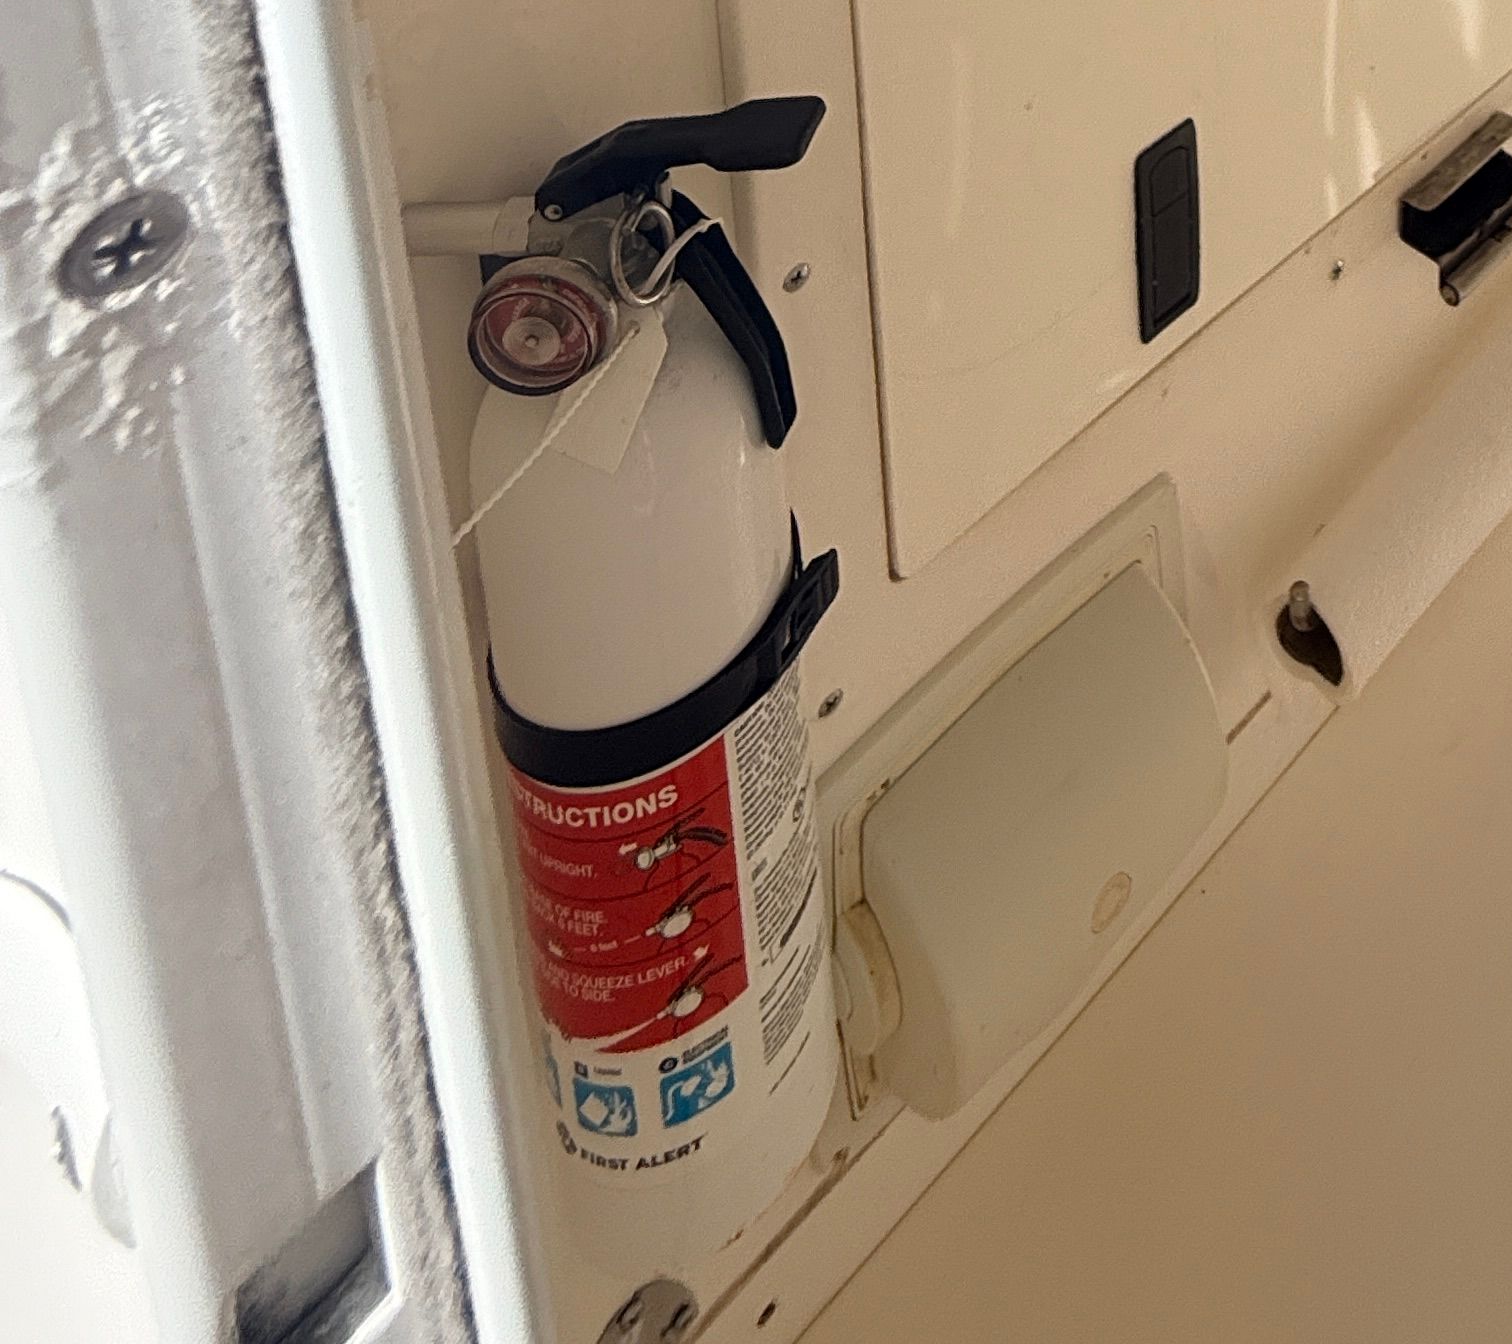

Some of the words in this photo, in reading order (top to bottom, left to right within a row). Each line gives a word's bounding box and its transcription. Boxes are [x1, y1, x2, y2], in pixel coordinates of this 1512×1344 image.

[513, 784, 679, 828] STRUCTIONS
[572, 973, 634, 990] SQUEEZE
[580, 1147, 630, 1171] FIRST
[635, 1135, 706, 1171] ALERT
